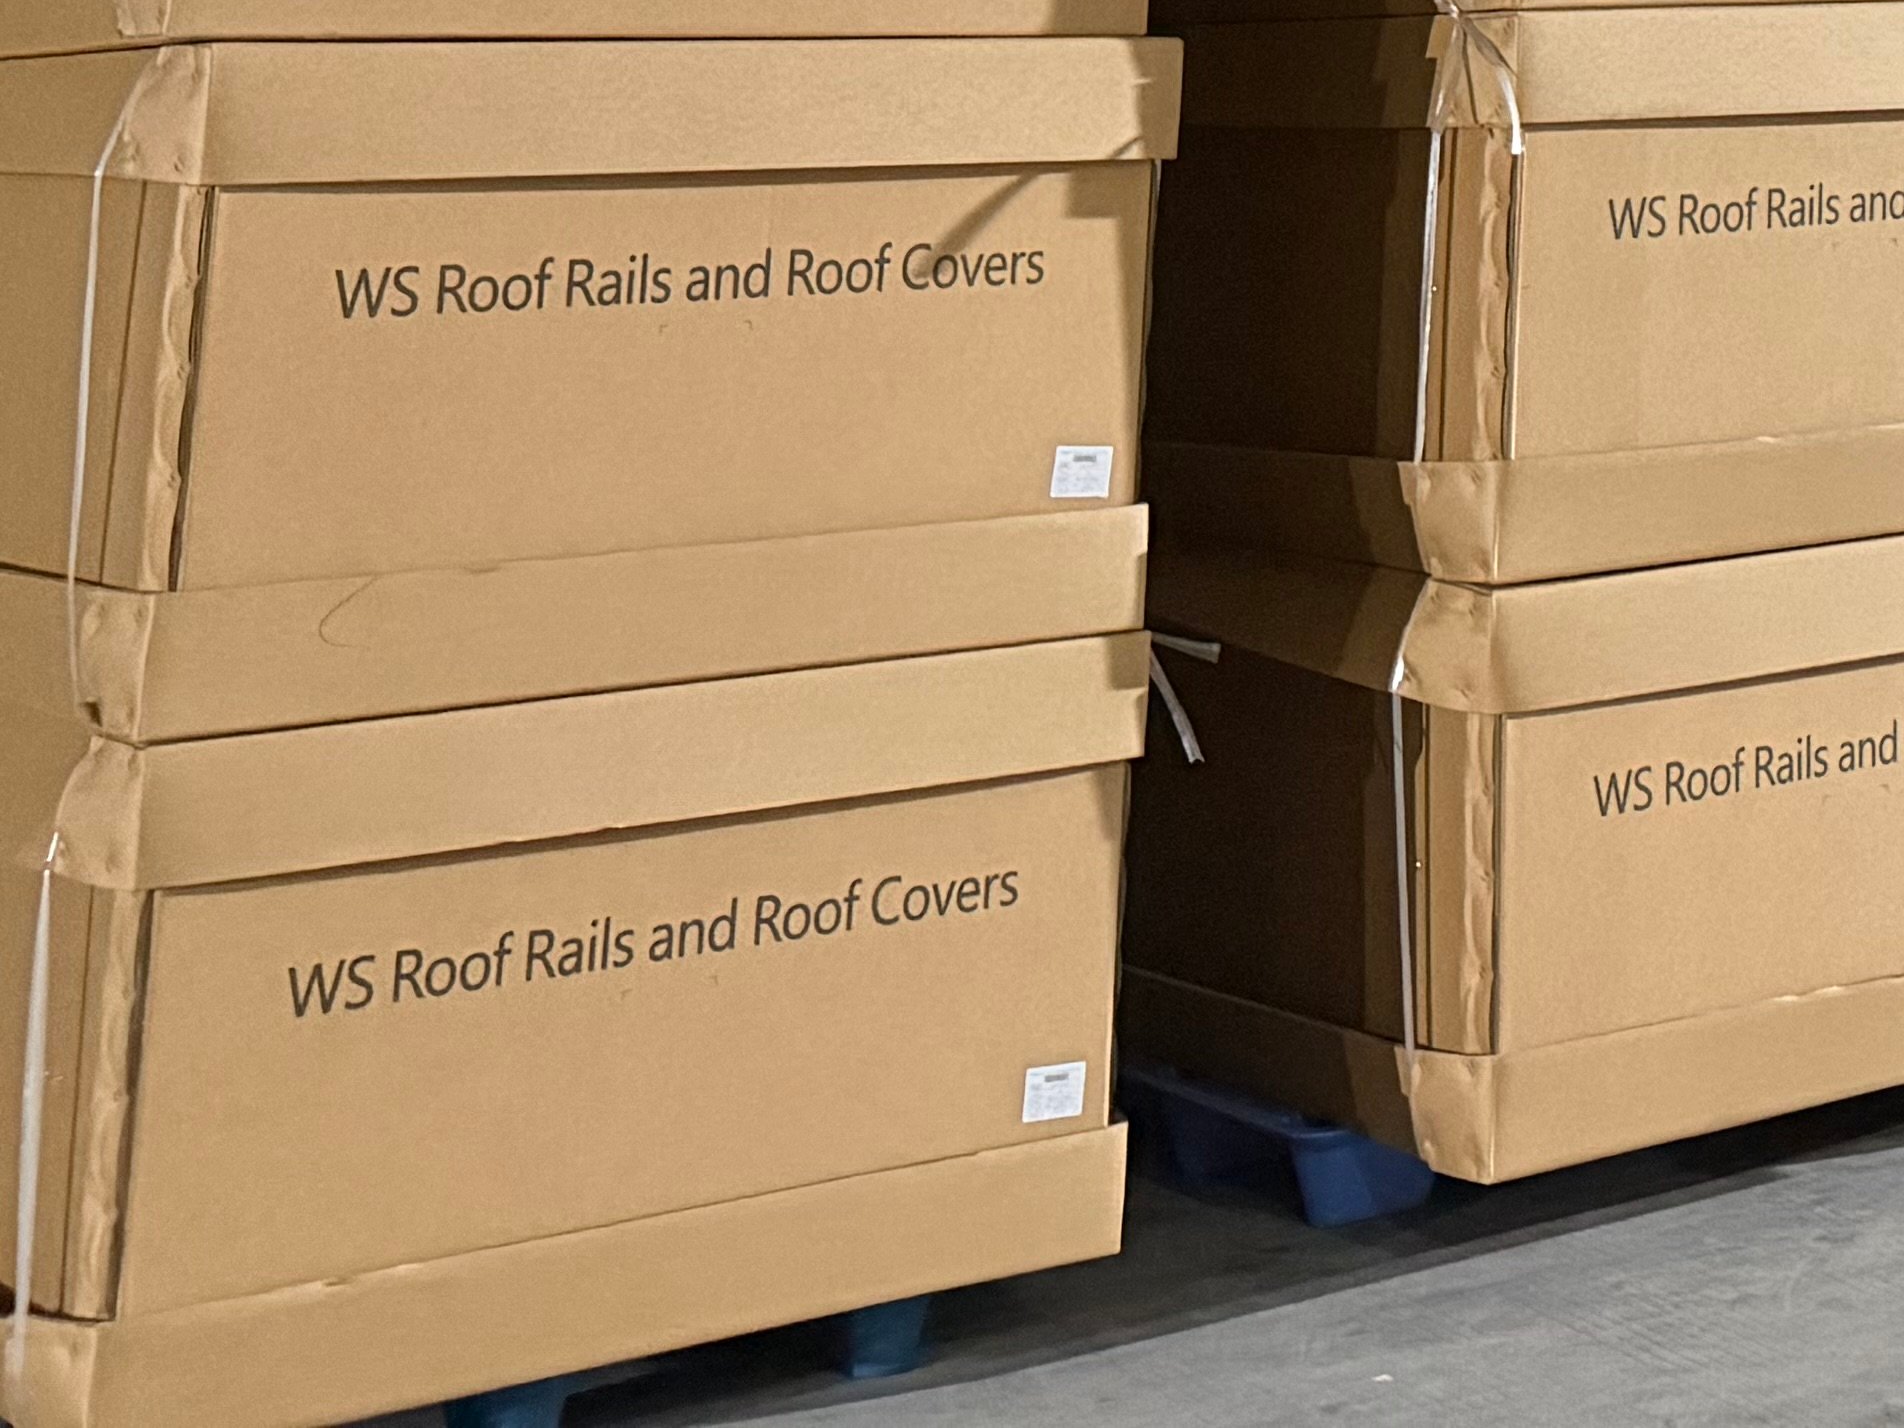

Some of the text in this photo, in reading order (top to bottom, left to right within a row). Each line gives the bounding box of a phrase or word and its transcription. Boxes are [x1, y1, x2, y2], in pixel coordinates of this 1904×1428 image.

[1609, 195, 1666, 240] WS
[1679, 187, 1758, 235] Roof
[1767, 182, 1840, 229] Rails
[335, 242, 1044, 319] WS Roof Rails and Roof Covers
[1593, 766, 1652, 817] WS
[1666, 746, 1745, 805] Roof
[1755, 735, 1828, 788] Rails
[1838, 719, 1897, 772] and
[288, 871, 1018, 1017] WS Roof Rails and Roof Covers
